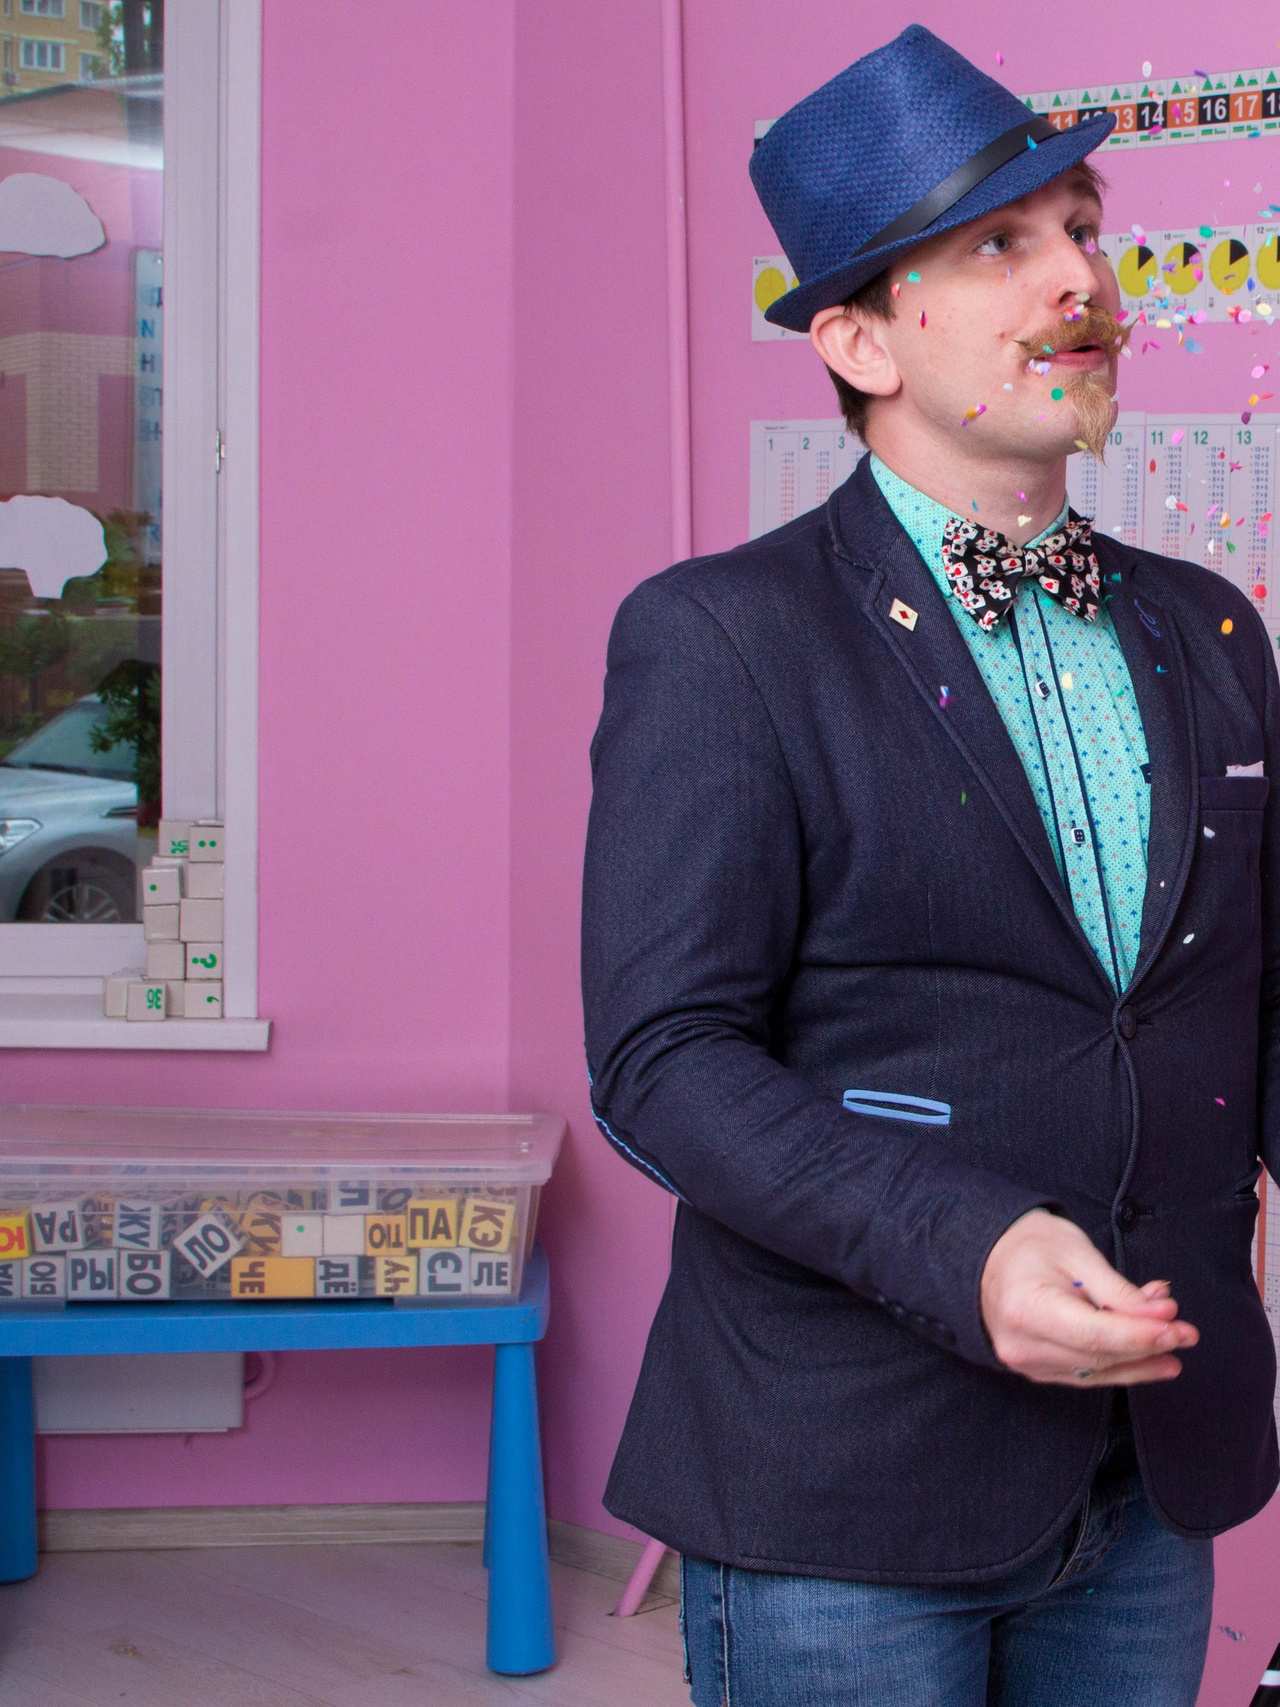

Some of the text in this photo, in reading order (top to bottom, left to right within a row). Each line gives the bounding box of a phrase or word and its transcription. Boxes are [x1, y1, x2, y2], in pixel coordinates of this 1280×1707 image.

[1141, 103, 1164, 126] 14
[1203, 98, 1226, 121] 16
[1235, 95, 1258, 118] 17
[768, 438, 773, 451] 1
[803, 437, 810, 450] 2
[838, 436, 845, 450] 3
[1108, 432, 1122, 446] 10
[1151, 430, 1164, 444] 11
[1193, 430, 1208, 445] 12
[1236, 430, 1252, 444] 13
[34, 1210, 79, 1244] РА
[118, 1203, 150, 1248] ЖУ
[368, 1223, 404, 1249] ТЮ
[410, 1208, 452, 1240] ПА
[468, 1204, 506, 1248] КЭ
[184, 1223, 230, 1271] ЛО
[30, 1261, 57, 1295] БЮ
[70, 1258, 114, 1291] РЫ
[126, 1253, 162, 1296] БО
[239, 1261, 265, 1294] ЧЕ
[319, 1260, 358, 1294] ДЁ
[384, 1260, 410, 1292] ЧУ
[428, 1251, 462, 1292] ГЭ
[473, 1261, 508, 1286] ЛЕ
